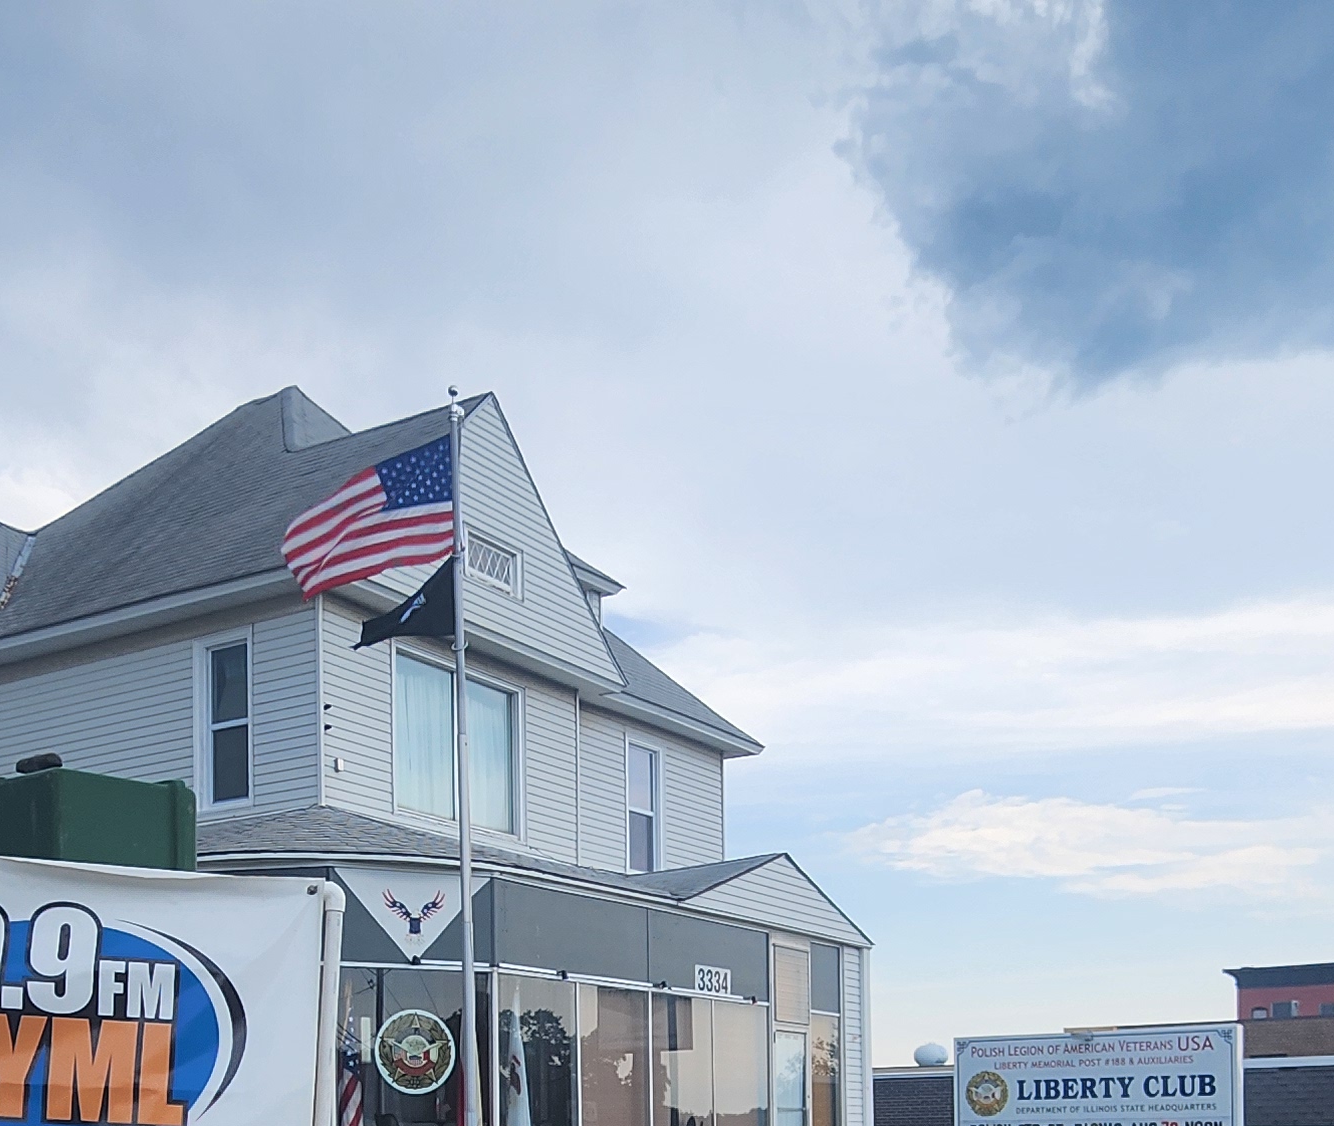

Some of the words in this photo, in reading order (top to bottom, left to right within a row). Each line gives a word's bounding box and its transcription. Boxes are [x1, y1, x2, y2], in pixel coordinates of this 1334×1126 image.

[97, 959, 177, 1021] FM
[697, 967, 728, 995] 3334
[970, 1046, 1005, 1058] POLISH
[1008, 1044, 1044, 1056] LEGION
[1047, 1044, 1061, 1055] OF
[1063, 1042, 1115, 1054] AMERICAN
[1118, 1039, 1173, 1052] VETERANS
[1177, 1035, 1214, 1051] USA
[993, 1061, 1028, 1070] LIBERTY
[1031, 1059, 1076, 1068] MEMORIAL
[1078, 1058, 1102, 1067] POST
[1128, 1057, 1135, 1065] &
[1137, 1055, 1194, 1064] AUXILIARIES
[1016, 1076, 1135, 1101] LIBERTY
[1143, 1074, 1216, 1098] CLUB
[1015, 1106, 1067, 1115] DEPARTMENT
[1069, 1105, 1080, 1114] OF
[1083, 1105, 1118, 1114] ILLINOIS
[1120, 1104, 1145, 1112] STATE
[1148, 1103, 1217, 1112] HEADQUARTERS
